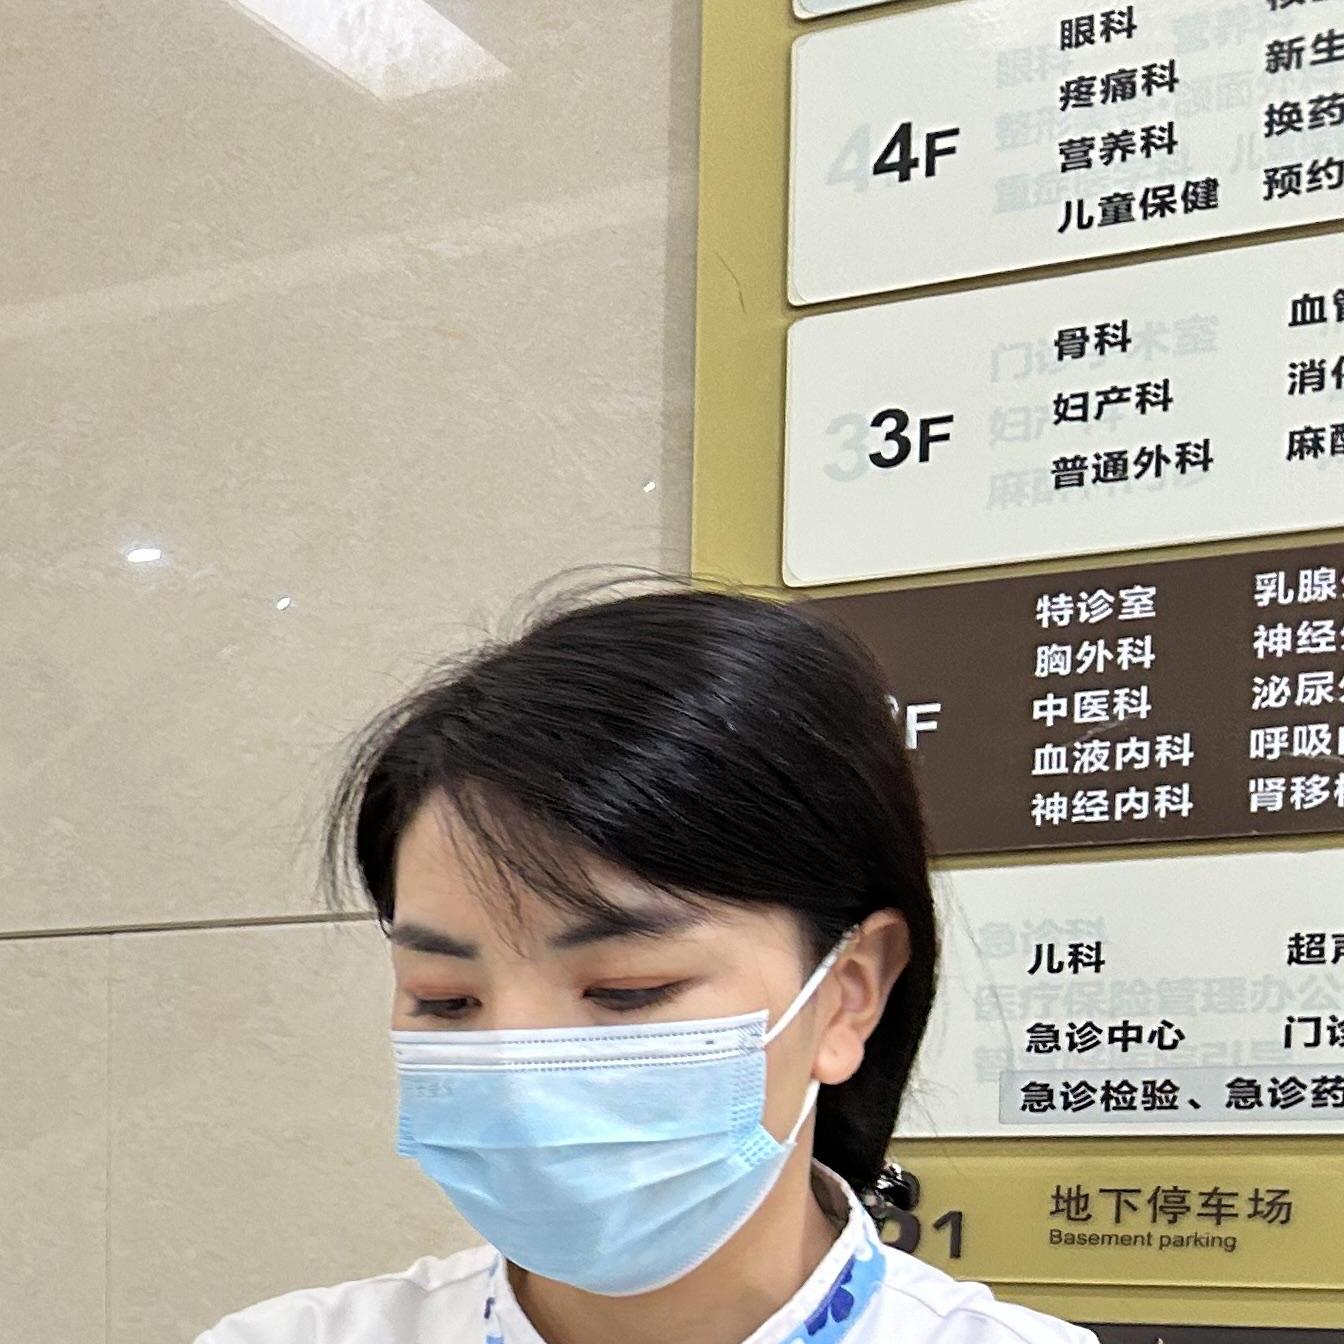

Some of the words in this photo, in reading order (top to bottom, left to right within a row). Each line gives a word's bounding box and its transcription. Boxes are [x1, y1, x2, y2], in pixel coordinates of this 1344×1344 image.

[1061, 6, 1137, 50] 眼科
[1060, 59, 1178, 111] 疼痛科
[873, 122, 959, 182] 4F
[1059, 122, 1177, 173] 营养科
[1058, 178, 1219, 233] 儿童保健
[1055, 320, 1131, 361] 骨科
[1054, 379, 1173, 425] 妇产科
[869, 409, 953, 468] 3F
[1052, 439, 1213, 489] 普通外科
[1037, 586, 1155, 628] 特诊室
[1255, 567, 1344, 606] 乳腺
[1035, 635, 1155, 677] 胸外科
[1254, 620, 1344, 658] 神经
[1033, 686, 1151, 726] 中医科
[1252, 672, 1344, 709] 泌尿
[1032, 733, 1194, 774] 血液内科
[1250, 724, 1344, 760] 呼吸
[1032, 783, 1193, 825] 神经内科
[1028, 941, 1105, 974] 儿科
[1026, 1020, 1185, 1053] 急诊中心
[1021, 1076, 1344, 1112] 急诊检验、急诊药
[1050, 1185, 1292, 1226] 地下停车场
[1050, 1229, 1152, 1247] Basement
[1159, 1232, 1237, 1252] parking
